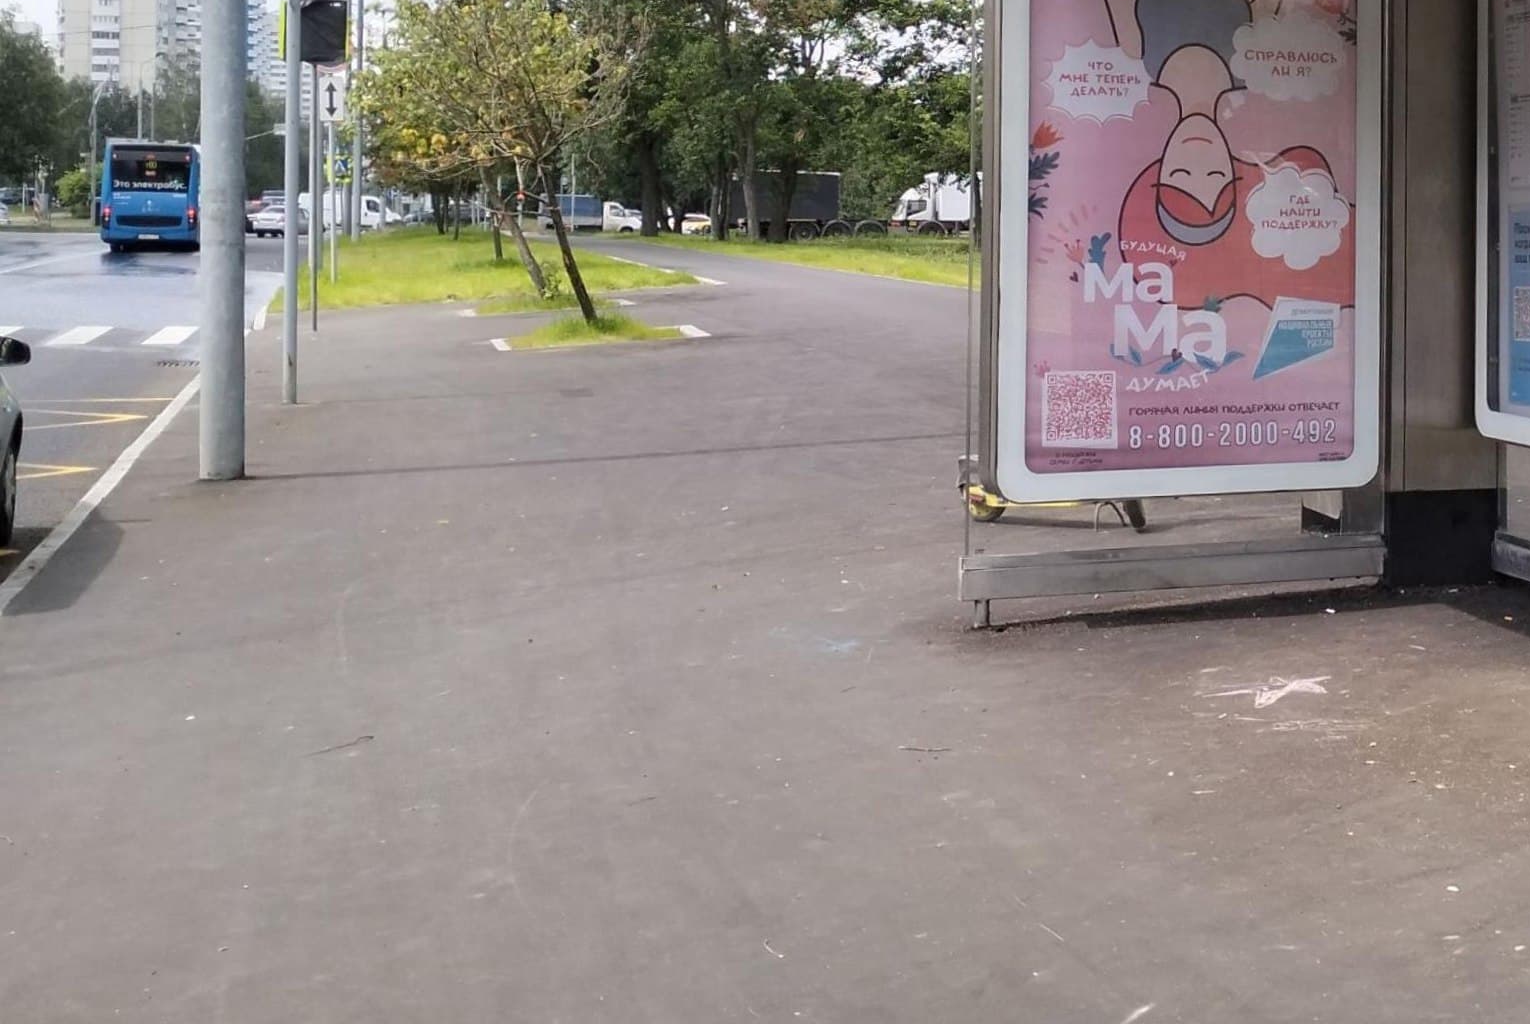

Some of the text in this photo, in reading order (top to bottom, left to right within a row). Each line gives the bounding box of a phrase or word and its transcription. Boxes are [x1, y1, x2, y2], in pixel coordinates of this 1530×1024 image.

[1244, 49, 1338, 64] СПРАВЛЮСЬ
[1088, 61, 1114, 72] ЧТО
[1271, 66, 1313, 77] ЛИ Я?
[1060, 73, 1141, 85] МНЕ ТЕПЕРЬ
[1070, 85, 1130, 97] ДЕЛАТЬ?
[1289, 194, 1311, 205] ГДЕ
[1262, 220, 1338, 231] ПОДДЕРЖКУ?
[1120, 240, 1187, 262] БУДУЩАЯ
[1126, 370, 1210, 392] ДУМАЕТ
[1222, 402, 1285, 415] ПОДДЕРЖКИ
[1288, 401, 1340, 412] ОТВЕЧАЕТ
[1129, 419, 1336, 450] 8-800-2000-492
